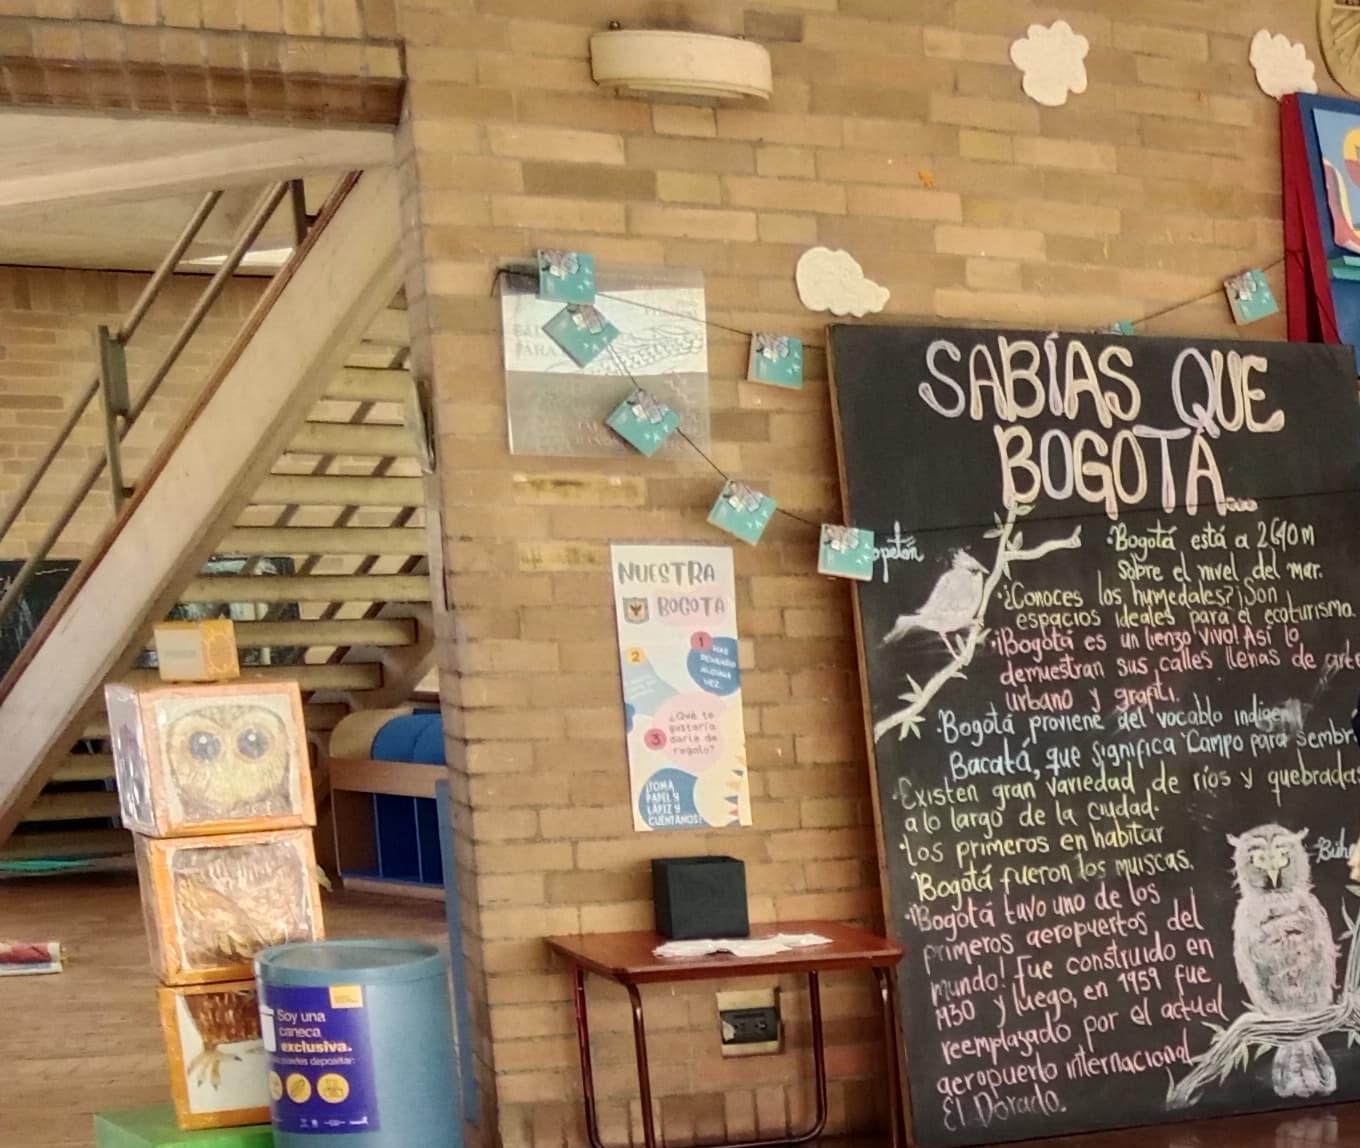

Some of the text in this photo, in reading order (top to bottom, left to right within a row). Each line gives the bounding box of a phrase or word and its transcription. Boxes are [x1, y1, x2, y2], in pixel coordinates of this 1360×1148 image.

[918, 332, 1285, 438] SABÍAS QUE
[871, 520, 926, 584] opetón
[1110, 520, 1177, 563] Bogotá
[1191, 525, 1228, 550] está
[1235, 533, 1251, 550] a
[617, 560, 716, 586] NUESTRA
[1118, 553, 1164, 582] sobre
[1173, 553, 1191, 583] el
[1197, 552, 1241, 582] nivel
[1250, 548, 1280, 580] del
[1002, 582, 1084, 610] ¿Conoces
[1098, 570, 1122, 607] los
[1015, 606, 1101, 638] espacios
[1115, 603, 1176, 629] ideales
[1189, 610, 1230, 636] para
[1237, 606, 1253, 626] el
[1084, 634, 1108, 652] es
[1120, 632, 1141, 650] un
[1145, 626, 1192, 651] lienzo
[1199, 623, 1240, 647] vivo!
[1284, 623, 1300, 648] lo
[631, 651, 641, 663] 2
[999, 653, 1106, 687] demuestran
[1116, 657, 1150, 677] sus
[1159, 649, 1214, 674] calles
[1225, 645, 1281, 672] llenas
[1292, 642, 1317, 670] de
[939, 703, 1016, 748] Bogotá
[1029, 712, 1105, 745] proviene
[1118, 707, 1148, 732] del
[1156, 692, 1223, 729] vocablo
[1006, 684, 1074, 713] urbano
[1089, 687, 1101, 713] y
[651, 733, 661, 746] 3
[950, 737, 1042, 783] Bacatá,
[1046, 746, 1081, 776] que
[1092, 736, 1177, 770] significa
[1251, 731, 1289, 758] para
[1296, 717, 1358, 749] sembr
[897, 776, 979, 811] Existen
[992, 781, 1037, 811] gran
[1046, 761, 1136, 798] variedad
[1152, 760, 1182, 794] de
[1240, 767, 1254, 790] y
[904, 816, 919, 833] a
[923, 810, 942, 834] lo
[950, 806, 1004, 840] largo
[1019, 802, 1046, 829] de
[1055, 800, 1079, 827] la
[956, 835, 1050, 870] primeros
[1060, 834, 1089, 854] en
[1089, 820, 1166, 850] habitar
[1314, 828, 1352, 864] Búh
[910, 862, 994, 912] Bogotá
[1000, 866, 1075, 895] fueron
[1076, 852, 1107, 882] los
[1003, 894, 1047, 926] tuvo
[1052, 893, 1085, 919] uno
[1095, 886, 1121, 911] de
[1128, 880, 1161, 907] los
[922, 888, 1205, 976] primeros aeropuertos del
[1065, 931, 1177, 976] construido
[1186, 937, 1215, 960] en
[277, 1009, 327, 1025] Soy una
[992, 994, 1007, 1029] y
[1011, 981, 1079, 1022] luego,
[1083, 980, 1110, 1002] en
[1116, 966, 1163, 996] 1959
[1173, 963, 1213, 998] fue
[279, 1027, 322, 1038] caneca
[939, 983, 1230, 1067] reemplazado por el actual
[280, 1040, 353, 1054] exclusiva.
[935, 1027, 1194, 1100] aeropuerto internacional
[942, 1094, 967, 1132] El
